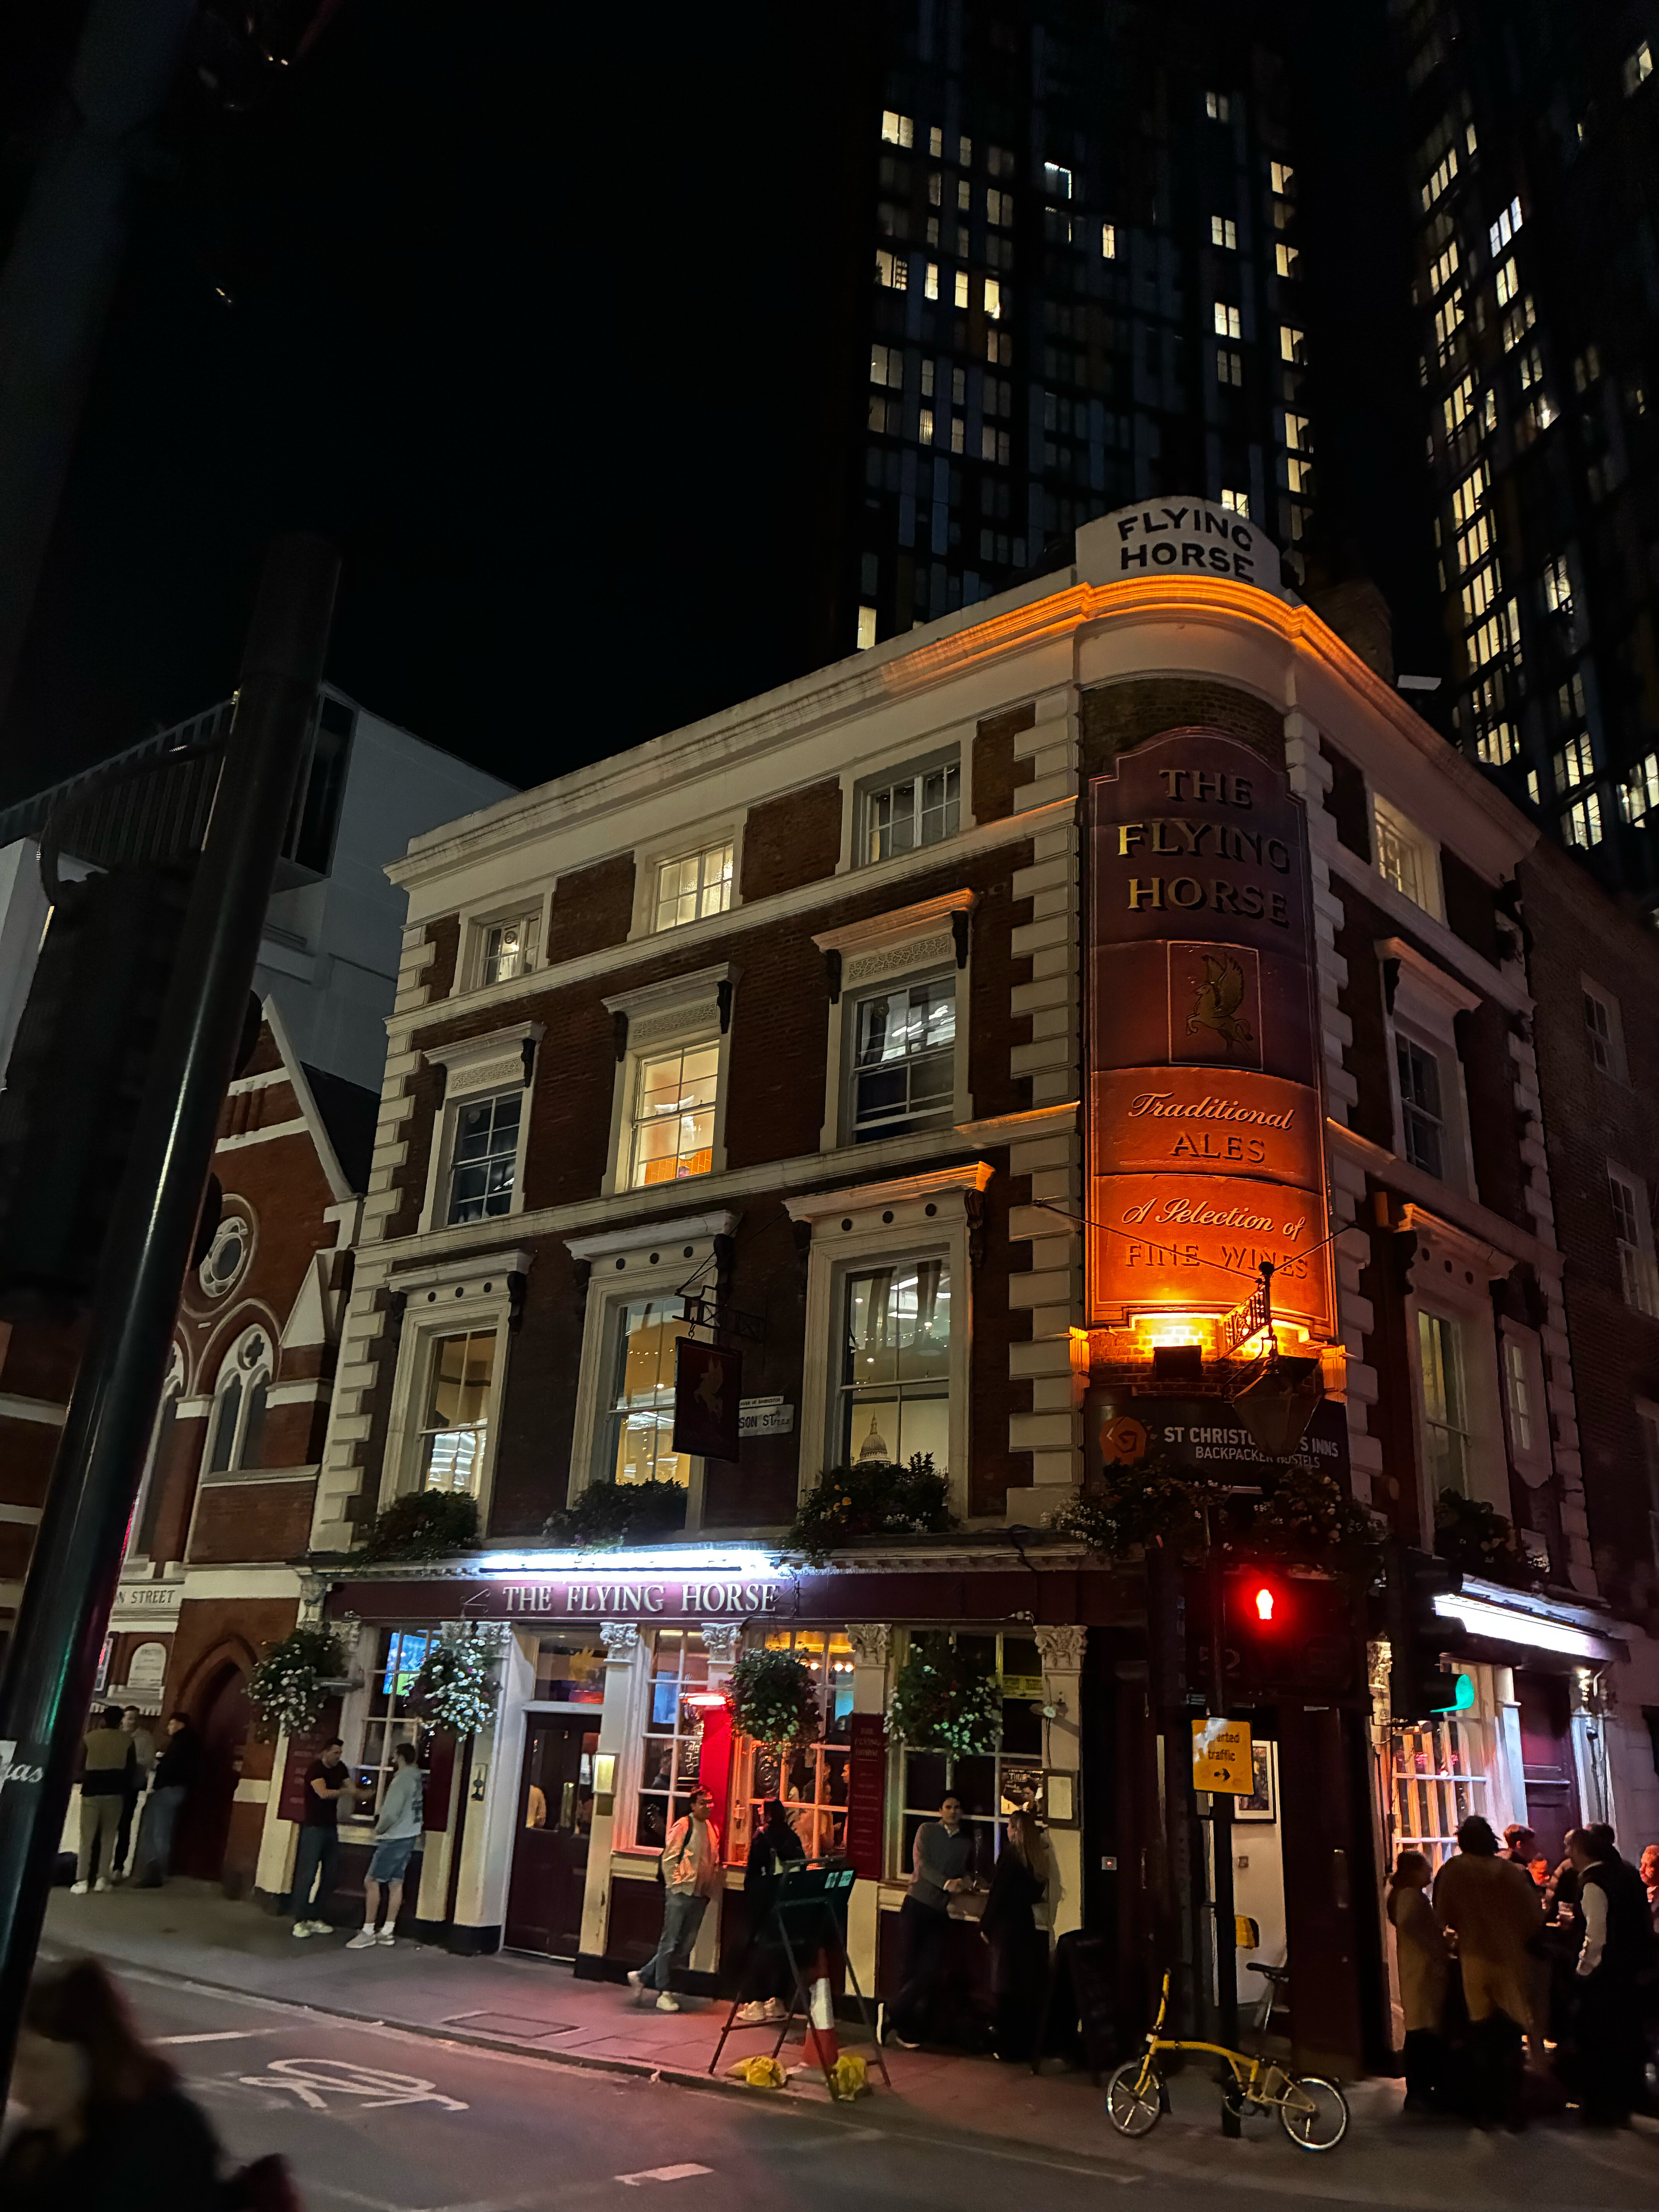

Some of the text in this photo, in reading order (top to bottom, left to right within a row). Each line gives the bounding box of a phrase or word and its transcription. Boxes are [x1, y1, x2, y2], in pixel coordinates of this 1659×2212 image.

[1118, 507, 1253, 551] FLYING
[1121, 543, 1254, 583] HORSE
[1159, 769, 1253, 810] THE
[1117, 821, 1290, 874] FLYING
[1127, 877, 1290, 929] HORSE
[1128, 1092, 1295, 1130] Traditional
[1169, 1131, 1265, 1163] ALES
[1121, 1197, 1306, 1241] A Selection of
[1125, 1243, 1308, 1279] FINE WINES
[738, 1415, 757, 1429] SON
[1164, 1427, 1185, 1443] ST
[1312, 1437, 1339, 1457] INNS
[131, 1590, 176, 1604] STREET
[503, 1583, 776, 1612] THE FLYING HORSE
[1208, 1749, 1236, 1761] traffic
